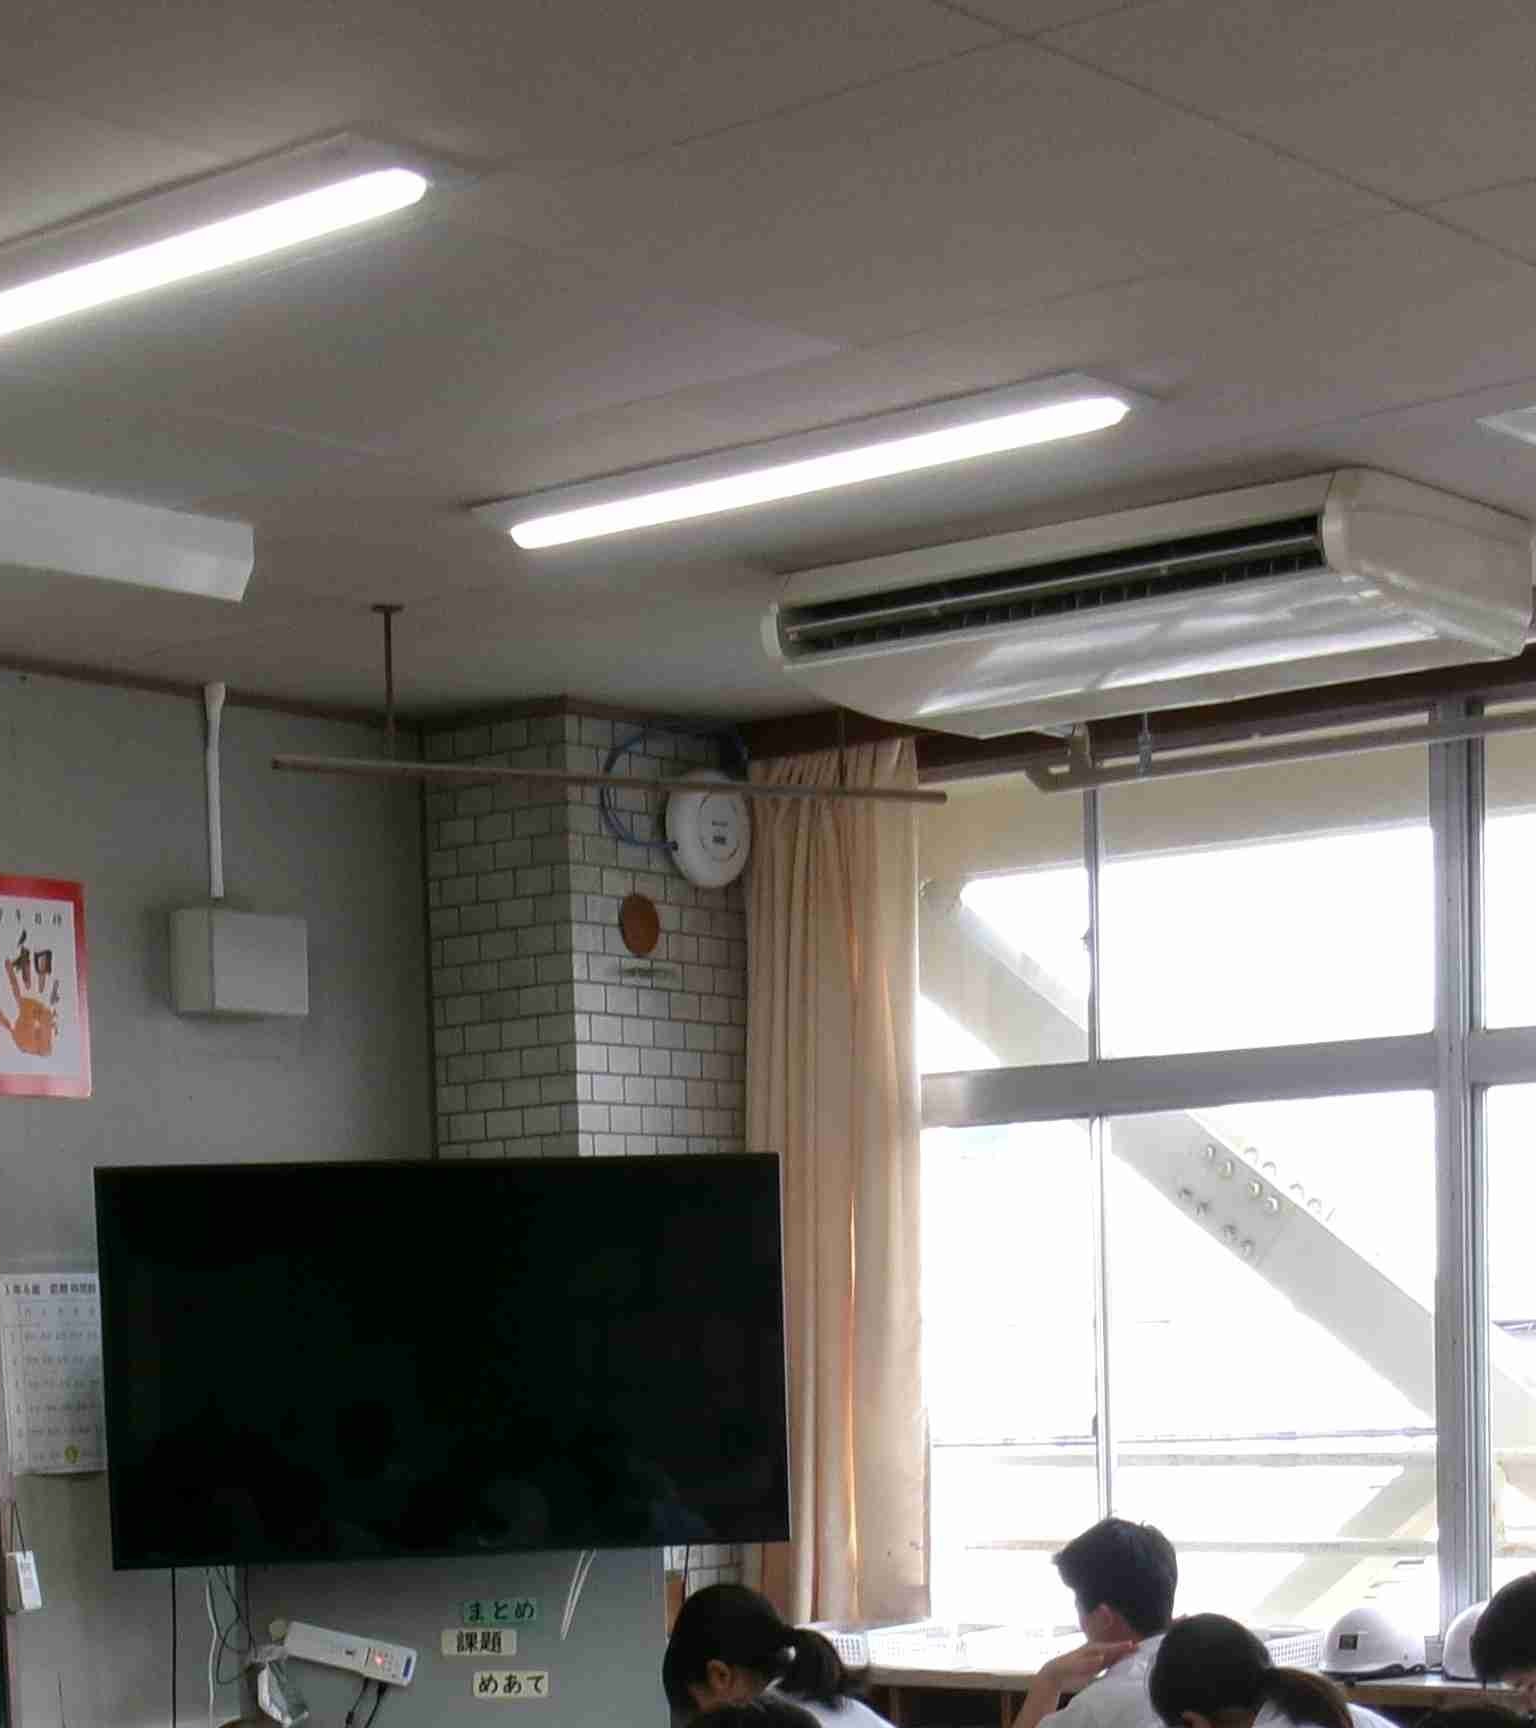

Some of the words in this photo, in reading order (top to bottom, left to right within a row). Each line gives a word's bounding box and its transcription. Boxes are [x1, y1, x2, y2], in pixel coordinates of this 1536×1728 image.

[467, 1601, 536, 1622] まとめ
[455, 1631, 503, 1654] 課題
[478, 1673, 545, 1696] めあて
